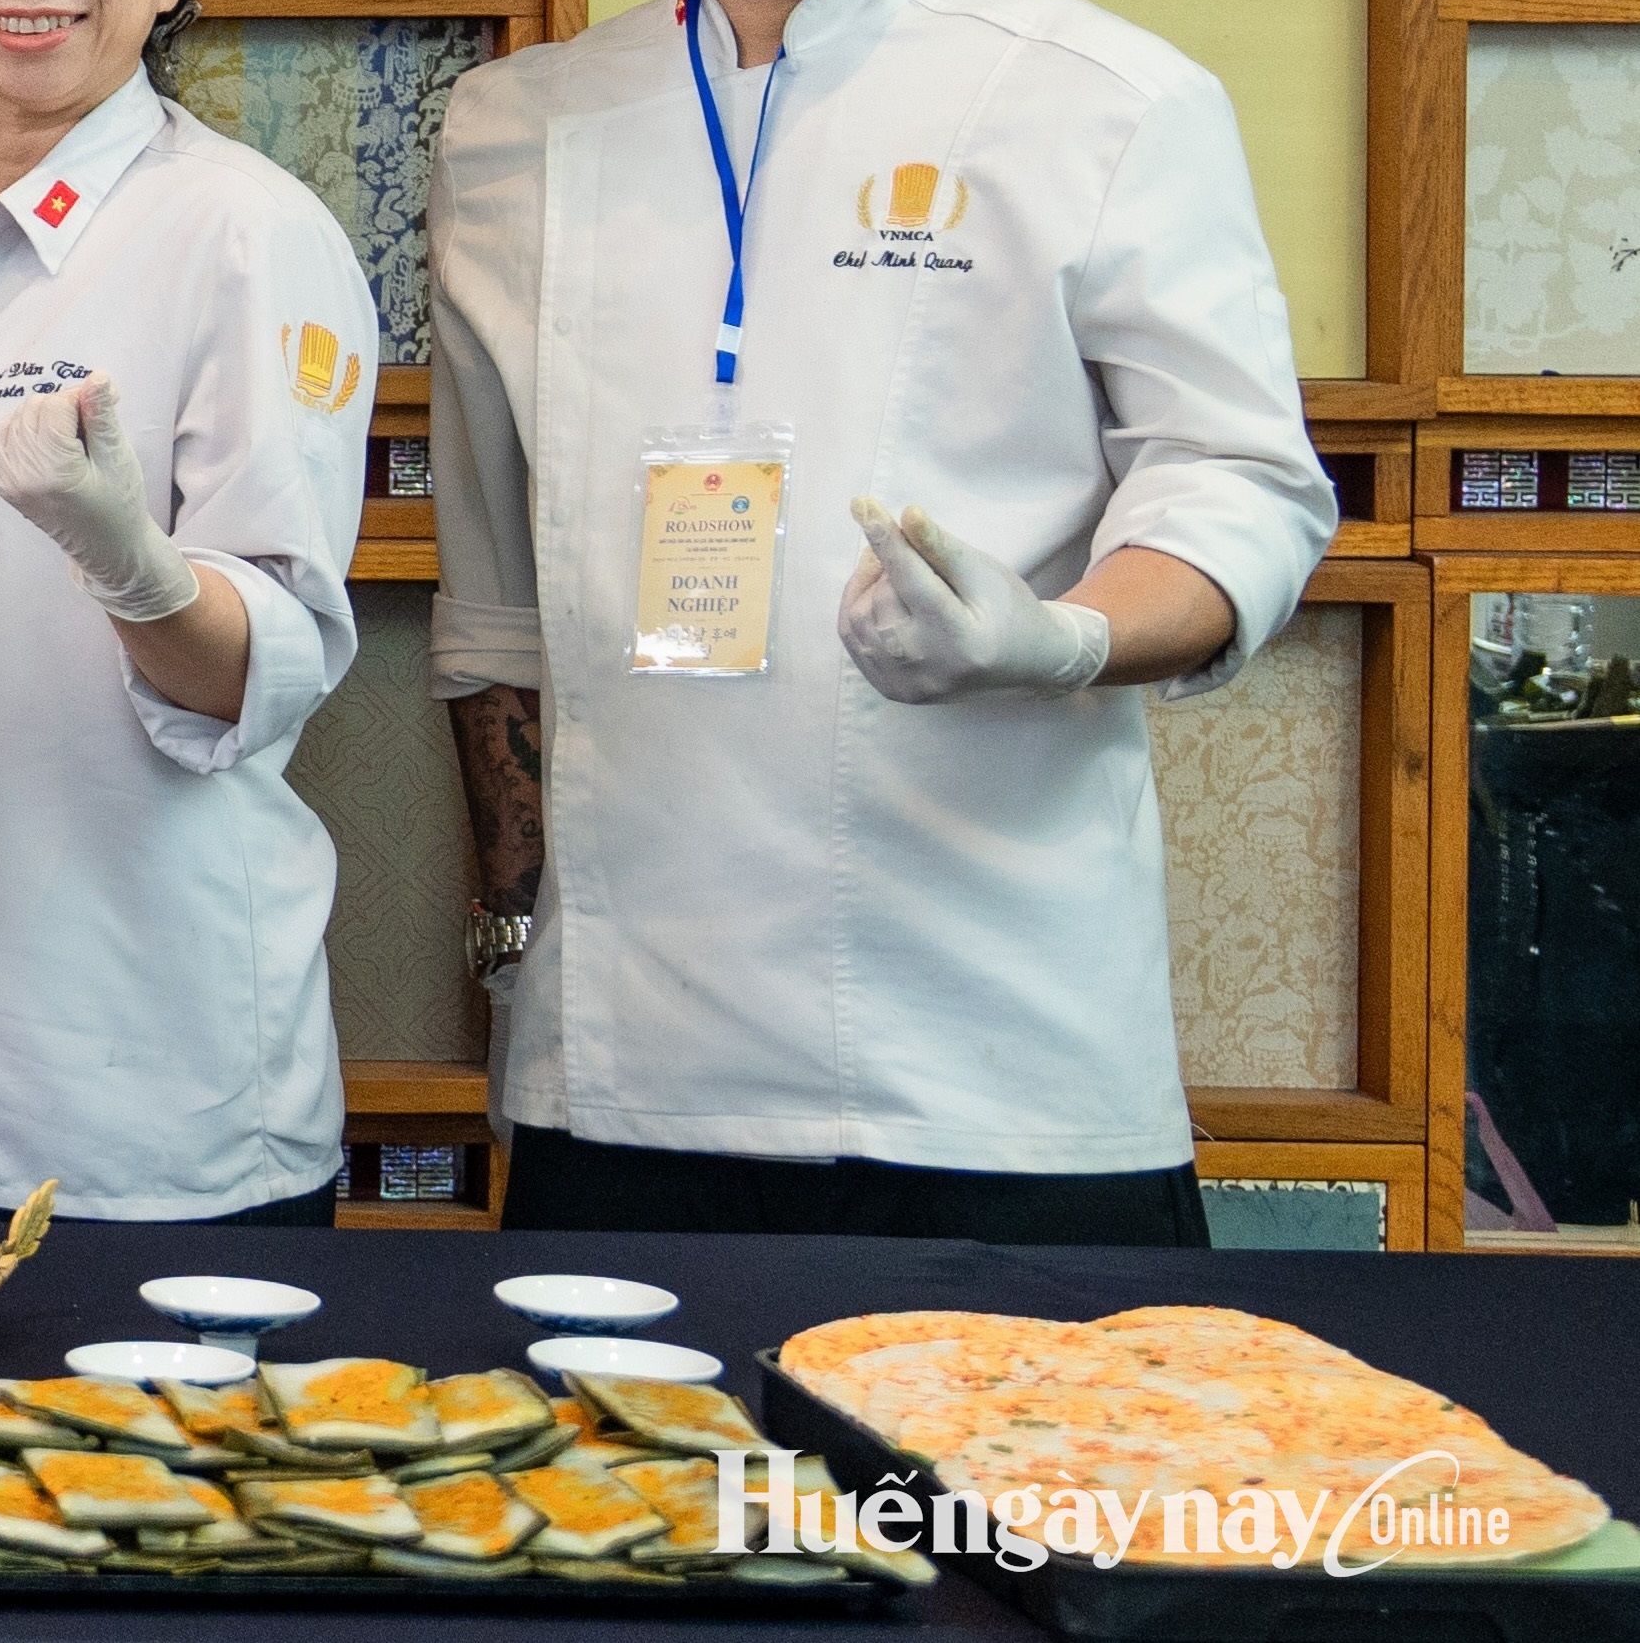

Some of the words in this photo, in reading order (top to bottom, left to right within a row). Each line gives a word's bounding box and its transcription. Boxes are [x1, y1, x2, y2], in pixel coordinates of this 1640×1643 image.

[879, 230, 934, 241] VNMCA
[833, 250, 867, 269] Chef
[871, 250, 916, 267] Minh
[924, 251, 973, 272] Quang
[665, 520, 756, 533] ROADSHOW
[672, 575, 739, 590] DOANH
[667, 595, 740, 616] NGHIỆP
